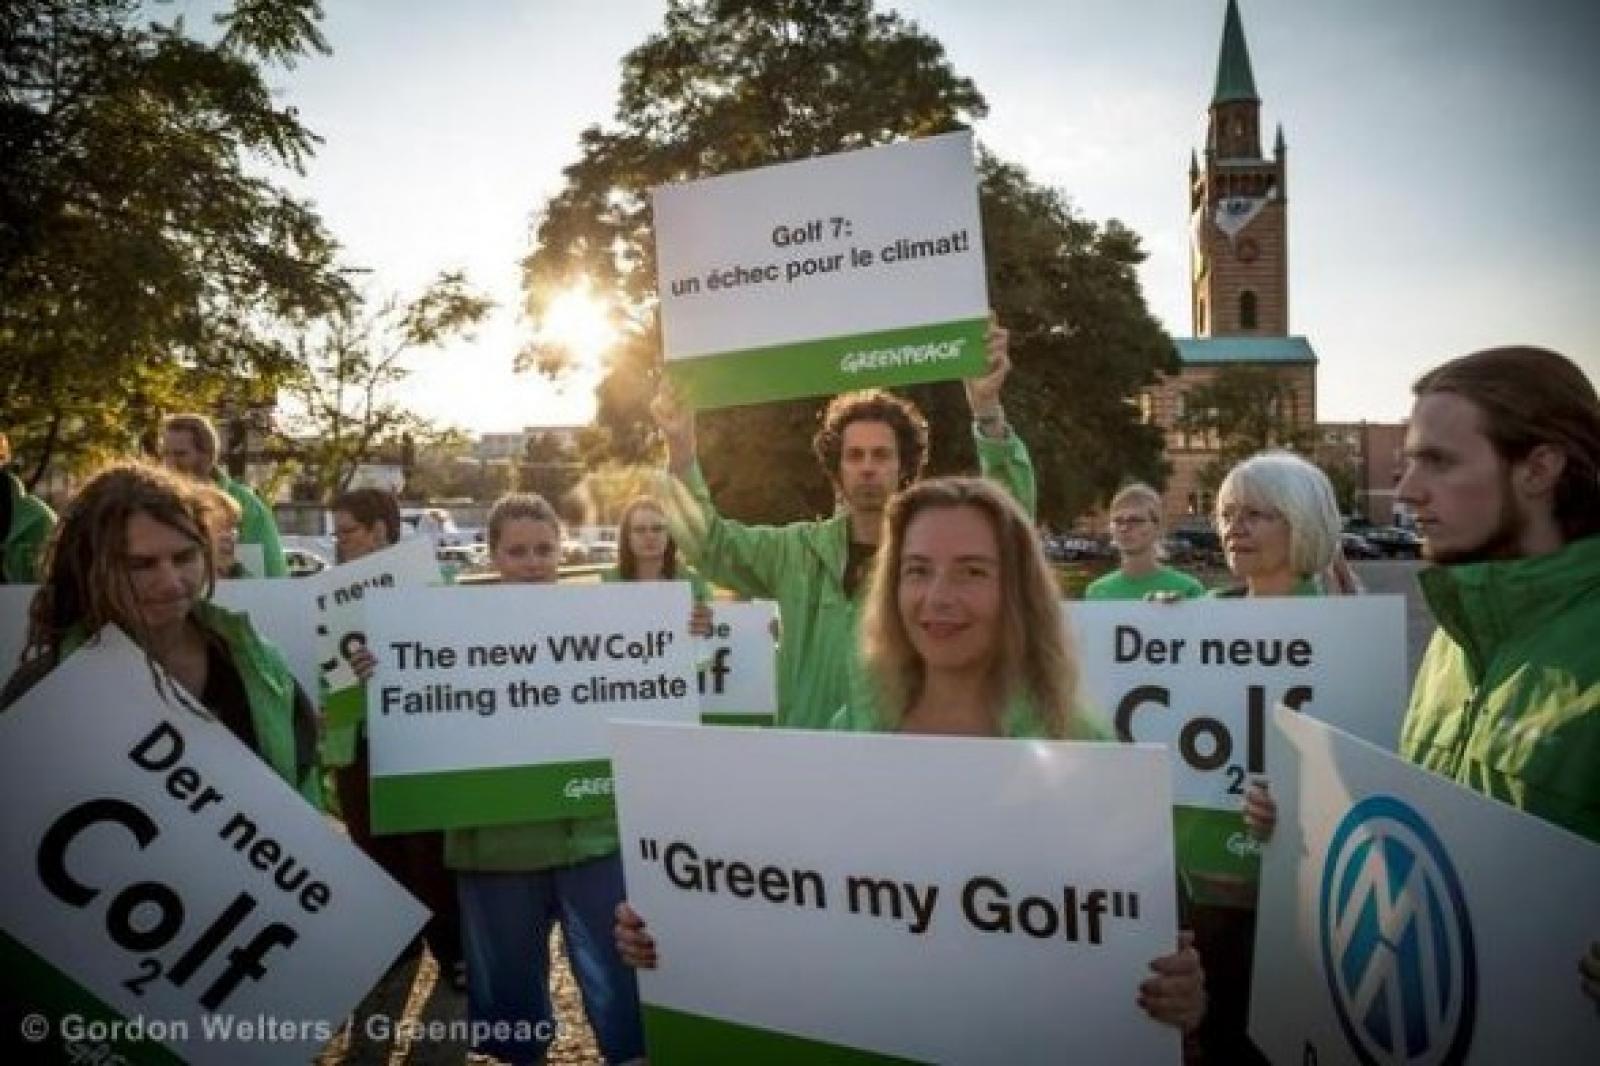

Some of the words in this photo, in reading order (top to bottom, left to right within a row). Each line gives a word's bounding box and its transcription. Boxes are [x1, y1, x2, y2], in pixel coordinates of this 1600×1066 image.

[772, 219, 822, 247] Golf
[829, 217, 852, 238] 7:
[671, 275, 700, 296] un
[706, 264, 779, 290] échec
[786, 253, 843, 282] pour
[851, 247, 873, 267] le
[881, 230, 969, 263] climat!
[390, 641, 457, 670] The
[467, 644, 537, 667] new
[1115, 625, 1186, 665] Der
[1200, 638, 1313, 666] neue
[381, 683, 497, 718] Failing
[508, 679, 561, 708] the
[571, 674, 687, 704] climate
[128, 720, 223, 813] Der
[218, 812, 331, 913] neue
[639, 838, 826, 909] "Green
[846, 874, 939, 933] my
[961, 876, 1141, 945] Golf"
